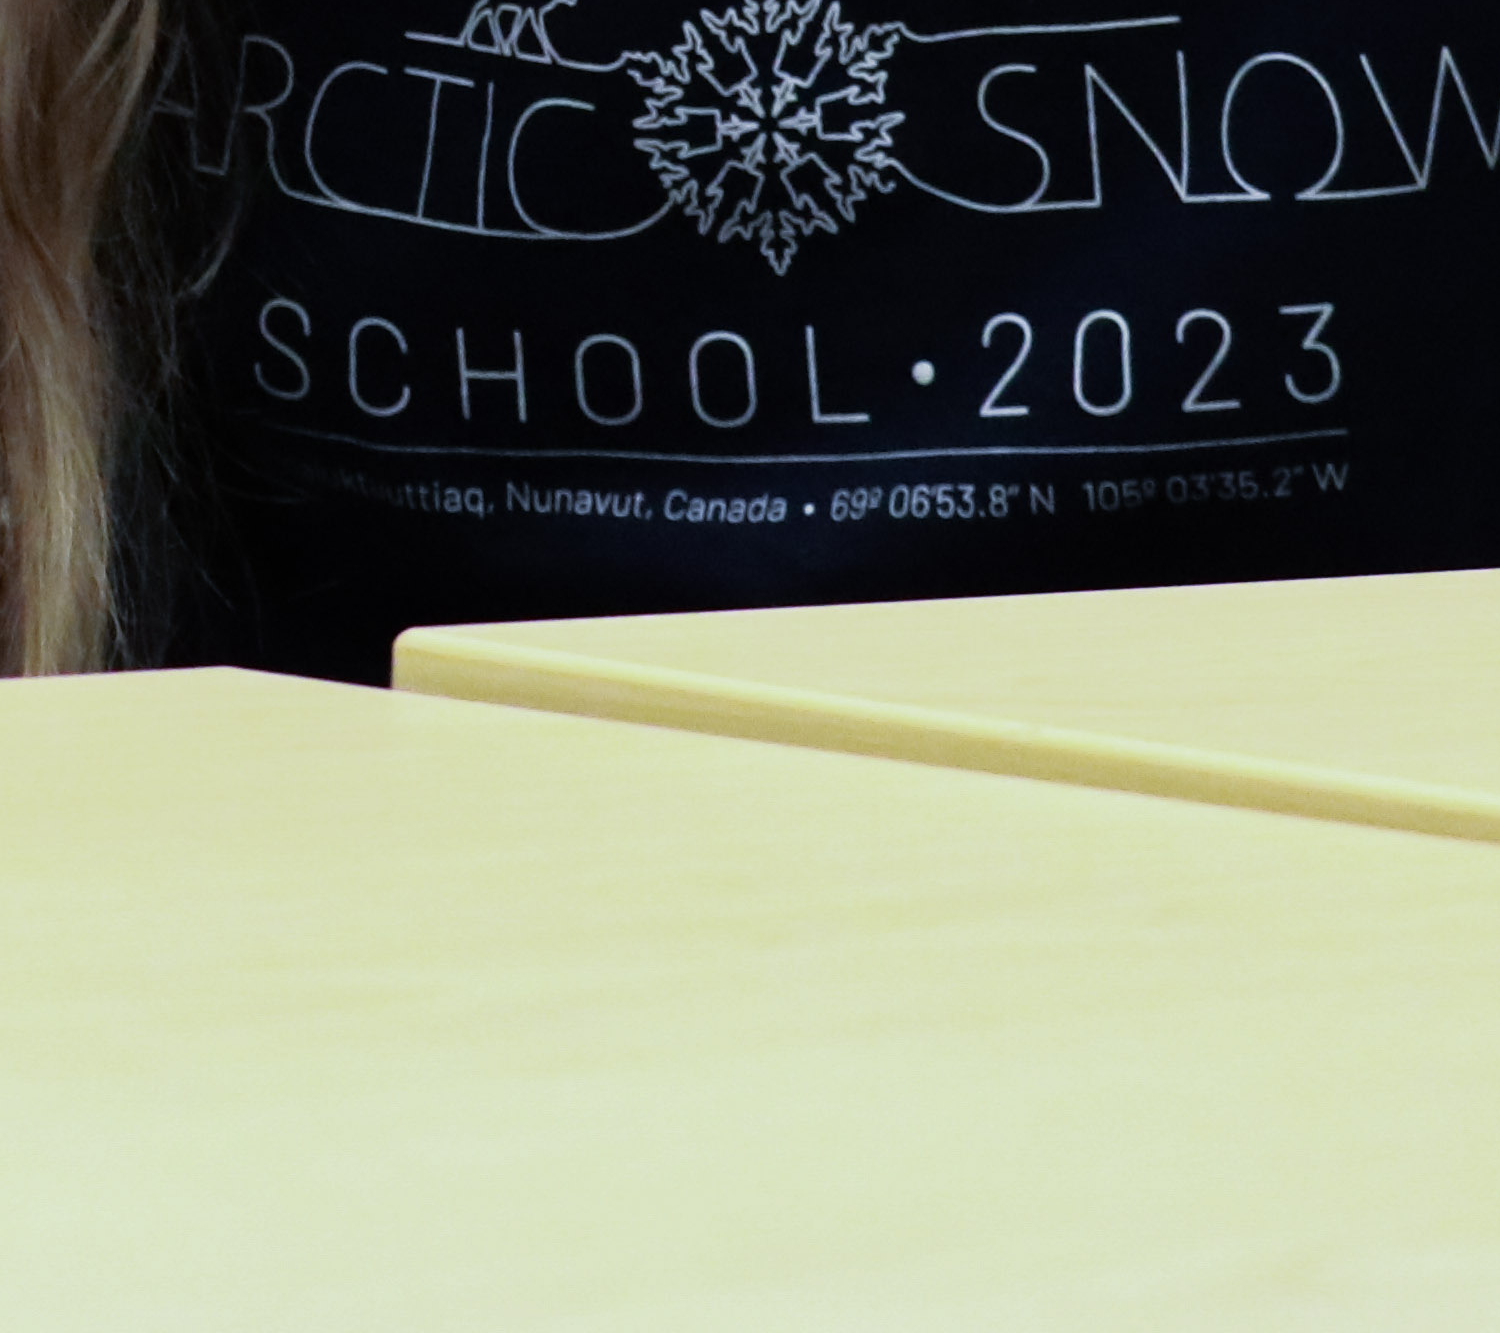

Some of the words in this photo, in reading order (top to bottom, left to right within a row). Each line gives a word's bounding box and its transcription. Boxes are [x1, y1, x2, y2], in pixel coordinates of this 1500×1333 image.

[141, 27, 598, 241] ARCTIC
[254, 297, 872, 429] SCHOOL
[979, 303, 1344, 417] 2023
[505, 481, 653, 520] Nunavut,
[663, 488, 788, 523] Canada
[1029, 484, 1055, 516] N
[1311, 461, 1351, 493] W
